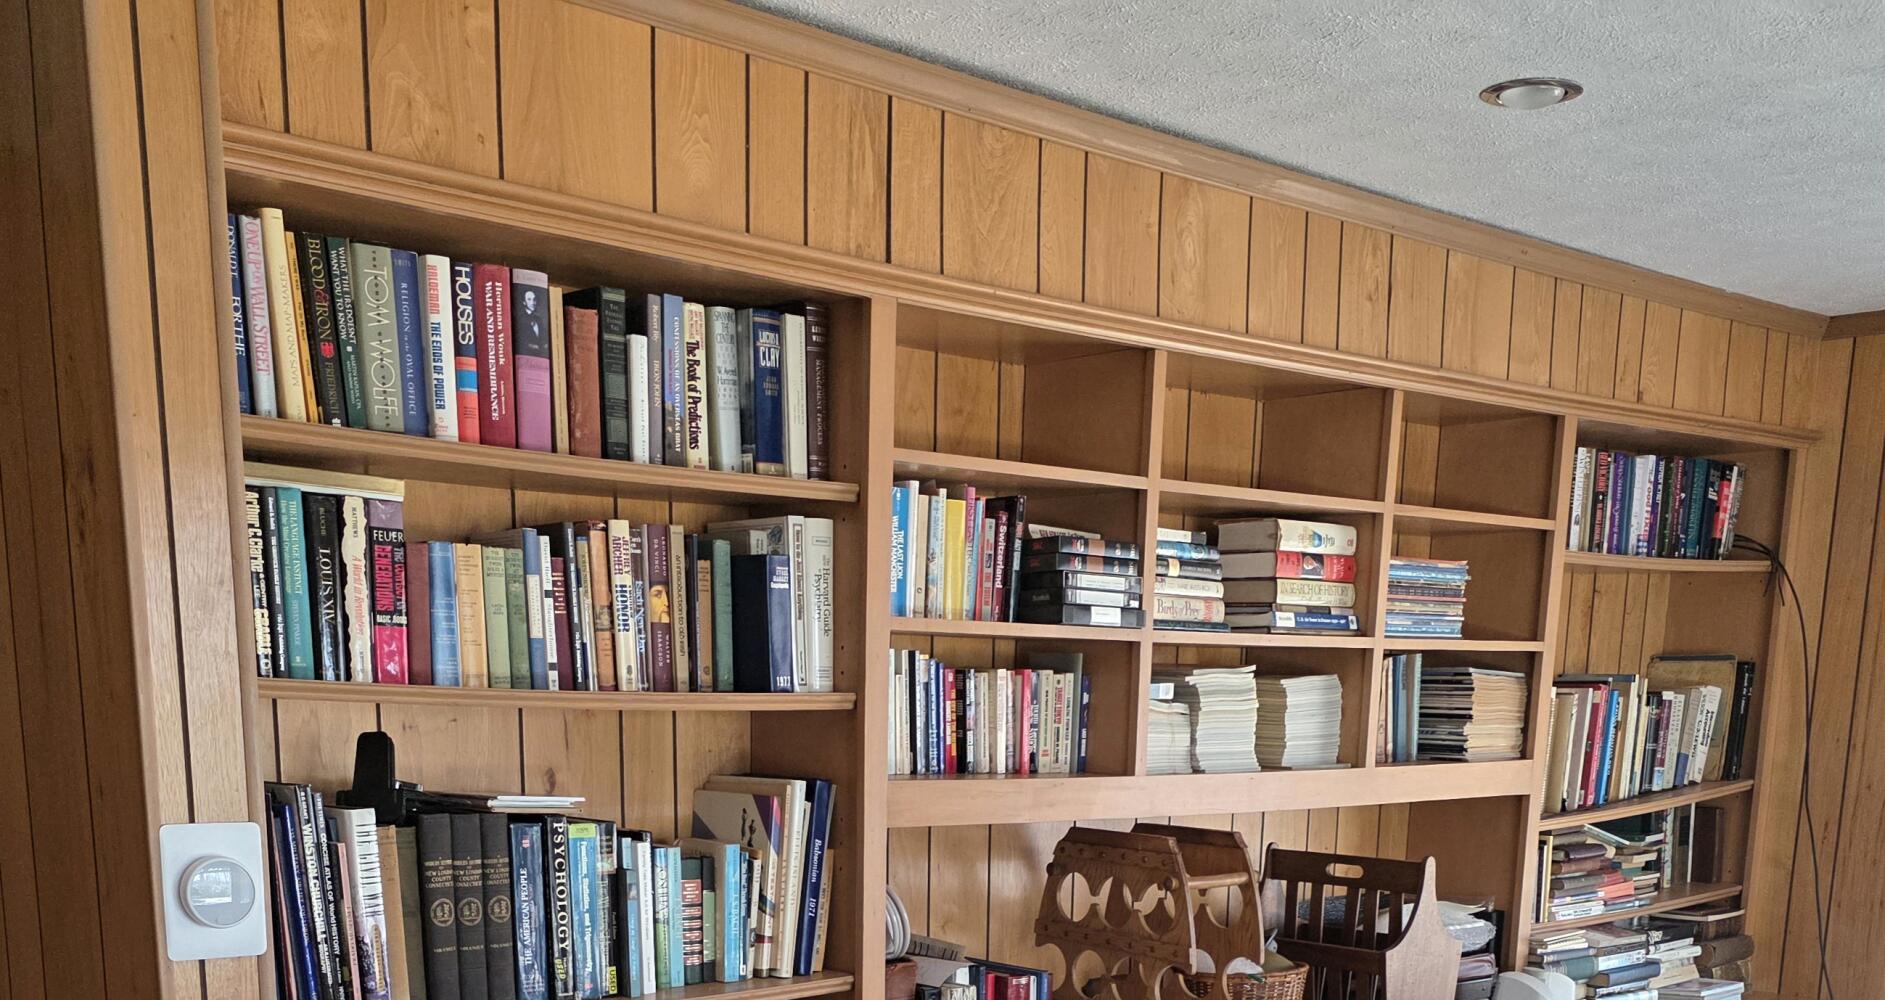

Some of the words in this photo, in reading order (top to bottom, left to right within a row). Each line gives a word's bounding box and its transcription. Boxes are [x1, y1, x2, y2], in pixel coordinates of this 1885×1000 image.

[244, 222, 261, 249] ONE
[248, 250, 262, 271] UP
[307, 239, 326, 288] BLOOD
[330, 250, 340, 275] WANT
[340, 247, 350, 273] WHAT
[333, 277, 343, 297] YOU
[342, 276, 351, 292] THE
[343, 294, 353, 305] IRS
[364, 267, 390, 327] TOM
[428, 264, 440, 315] HALDEMAN
[484, 281, 494, 306] WAR
[233, 297, 244, 322] FOR
[250, 284, 265, 322] WALL
[335, 299, 344, 309] TO
[401, 282, 410, 332] RELIGION
[455, 266, 474, 345] HOUSES
[495, 281, 504, 330] Herman
[652, 304, 660, 330] Robert
[315, 301, 332, 340] IRON
[337, 311, 348, 340] KNOW
[345, 305, 357, 344] DOESN'T
[431, 321, 442, 338] THE
[486, 308, 495, 333] AND
[233, 322, 246, 357] THE
[253, 323, 270, 376] STREET
[431, 340, 443, 363] ENDS
[497, 333, 506, 365] Wouk
[686, 340, 701, 357] The
[405, 353, 414, 378] OVAL
[433, 365, 444, 376] OF
[653, 360, 661, 381] IRON
[688, 358, 702, 381] Book
[759, 347, 780, 368] CLAY
[325, 362, 338, 414] FRIEDRICH
[370, 339, 398, 416] WOLFE
[487, 334, 499, 421] REMEMBRANCE
[674, 369, 681, 380] OF
[674, 382, 681, 392] AN
[688, 384, 702, 395] of
[407, 381, 416, 416] OFFICE
[434, 377, 446, 410] POWER
[653, 382, 661, 408] JOHN
[688, 396, 703, 450] Predictions
[674, 432, 682, 452] BRAT
[245, 491, 260, 527] Arthur
[351, 506, 359, 538] MATTHEWS
[247, 528, 262, 538] C.
[291, 515, 300, 558] LANGUAGE
[373, 530, 404, 543] FEUER
[653, 539, 660, 548] DA
[891, 516, 900, 547] WILLIAM
[896, 530, 905, 545] THE
[248, 538, 264, 573] Clarke
[612, 535, 624, 576] ARCHER
[622, 536, 631, 576] JEFFREY
[660, 536, 668, 576] LEONARDO
[897, 545, 905, 562] LAST
[995, 525, 1007, 588] Switzerland
[294, 559, 303, 595] INSTINCT
[318, 547, 334, 595] LOUIS
[375, 544, 395, 611] GENERATIONS
[890, 547, 899, 592] MANCHESTER
[813, 573, 822, 623] Psychiatry
[823, 567, 831, 607] Harvard
[1289, 582, 1313, 595] SEARCH
[1314, 584, 1322, 595] OF
[1323, 585, 1350, 597] HISTORY
[321, 595, 336, 625] XIV
[615, 584, 630, 633] HONOR
[823, 609, 831, 637] Guide
[1157, 599, 1178, 618] Birds
[1185, 601, 1200, 619] Prey
[303, 823, 319, 877] WINSTON
[320, 832, 330, 866] CONCISE
[581, 841, 590, 876] Functions,
[810, 839, 822, 883] Babsonian
[325, 867, 334, 890] ATLAS
[519, 868, 529, 900] PEOPLE
[553, 822, 569, 951] PSYCHOLOGY
[307, 879, 327, 942] CHURCHILL
[327, 891, 335, 902] OF
[808, 898, 817, 917] 1971
[328, 903, 337, 923] World
[520, 902, 531, 944] AMERICAN
[331, 924, 340, 955] HISTORY
[523, 949, 533, 966] THE
[556, 959, 566, 979] USED
[608, 969, 617, 993] USED
